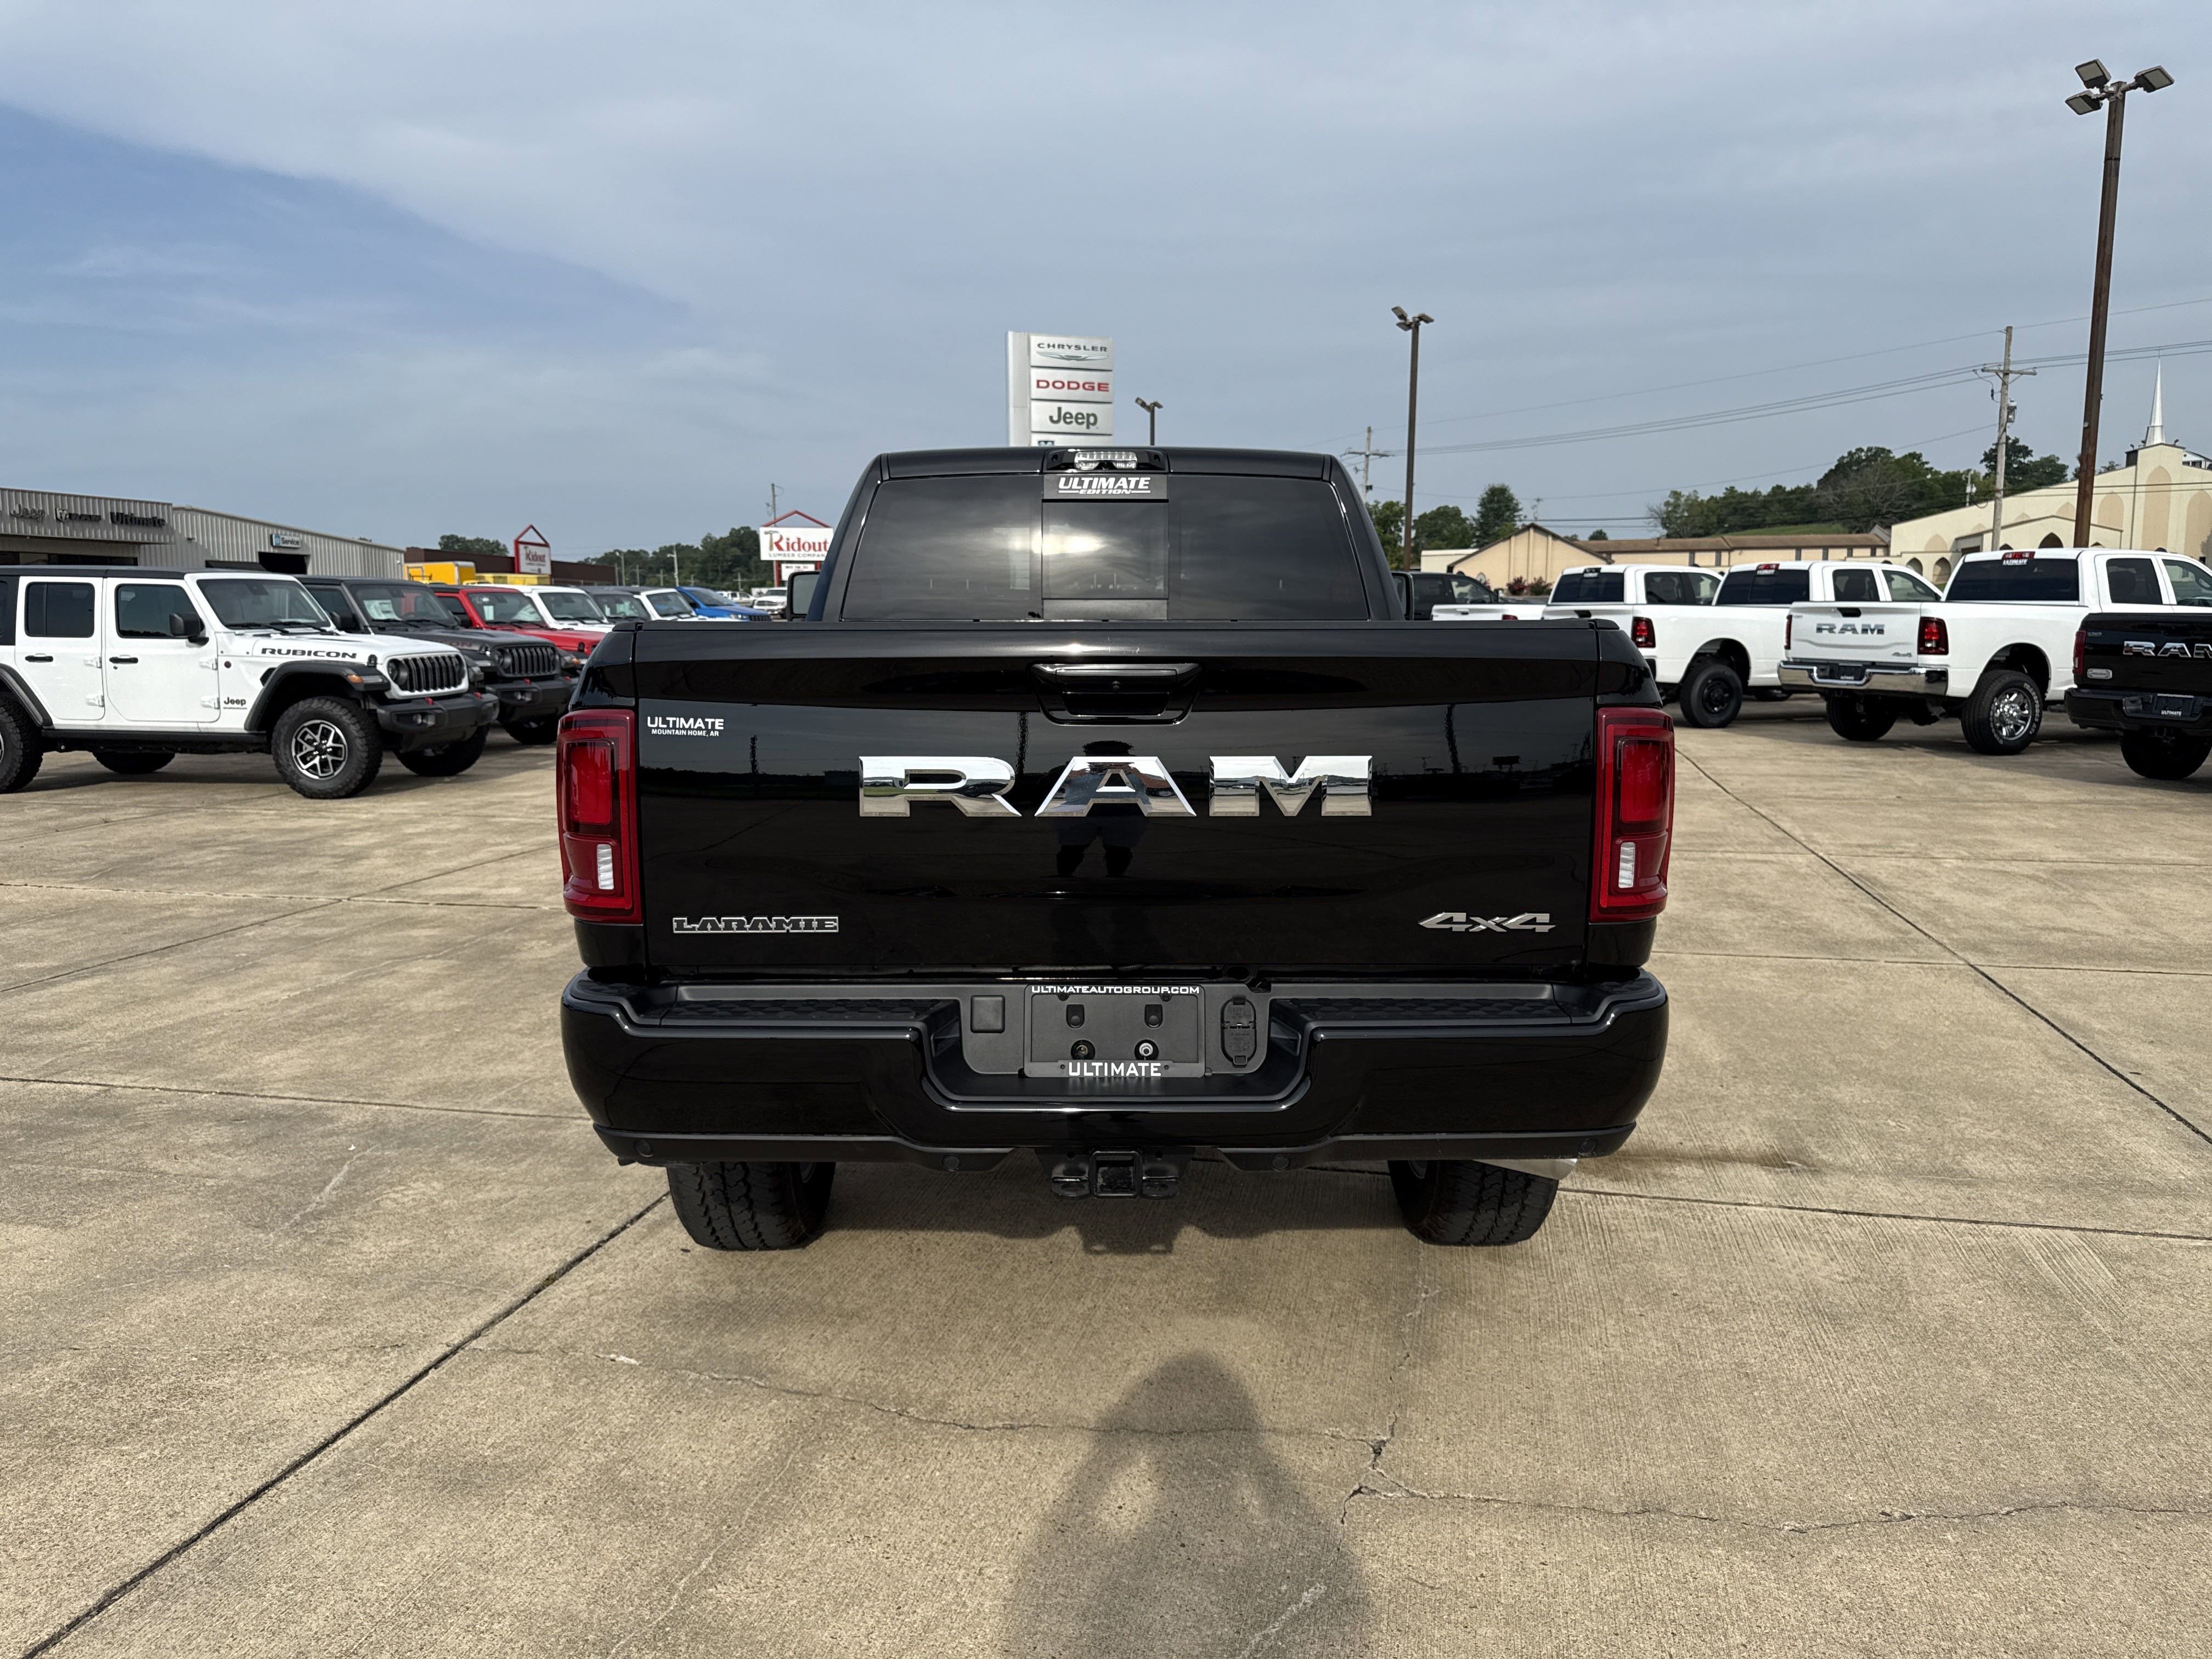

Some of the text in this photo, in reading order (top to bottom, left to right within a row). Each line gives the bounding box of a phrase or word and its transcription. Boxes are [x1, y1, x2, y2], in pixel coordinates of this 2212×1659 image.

[1037, 343, 1108, 352] CHRYSLER
[1036, 380, 1109, 392] DODGE
[1049, 407, 1098, 430] Jeep
[1058, 477, 1151, 489] ULTIMATE
[9, 504, 46, 522] Jeep
[110, 512, 166, 527] Ultimate
[764, 531, 830, 552] Ridout
[1816, 623, 1885, 635] RAM
[261, 648, 358, 659] RUBICON
[224, 697, 246, 707] Jeep
[647, 716, 724, 730] ULTIMATE
[859, 755, 1373, 817] RAM
[673, 916, 839, 933] LARAMIE
[1418, 912, 1556, 932] 4x4
[1031, 985, 1199, 994] ULTIMATEAUTOGROUP.COM
[1068, 1062, 1161, 1076] ULTIMATE
